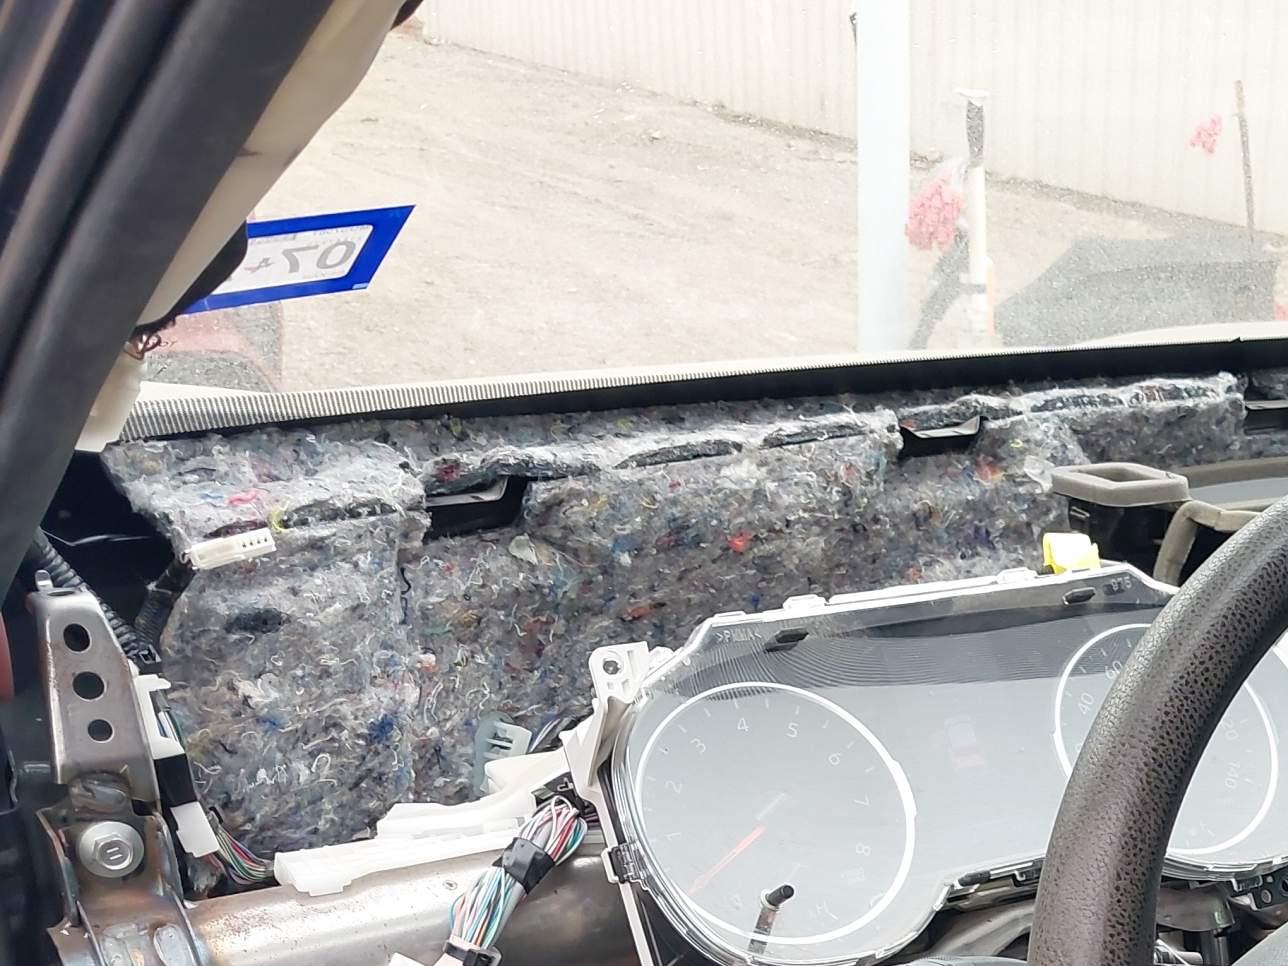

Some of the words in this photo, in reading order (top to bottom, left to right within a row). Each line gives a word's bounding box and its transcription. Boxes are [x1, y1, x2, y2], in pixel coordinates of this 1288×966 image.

[1104, 660, 1122, 680] 60
[1077, 692, 1095, 715] 40
[737, 718, 750, 733] 4
[785, 723, 799, 738] 5
[690, 738, 707, 753] 3
[828, 752, 841, 766] 6
[665, 780, 682, 793] 2
[854, 794, 872, 808] 7
[665, 830, 681, 842] 1
[855, 842, 872, 856] 8
